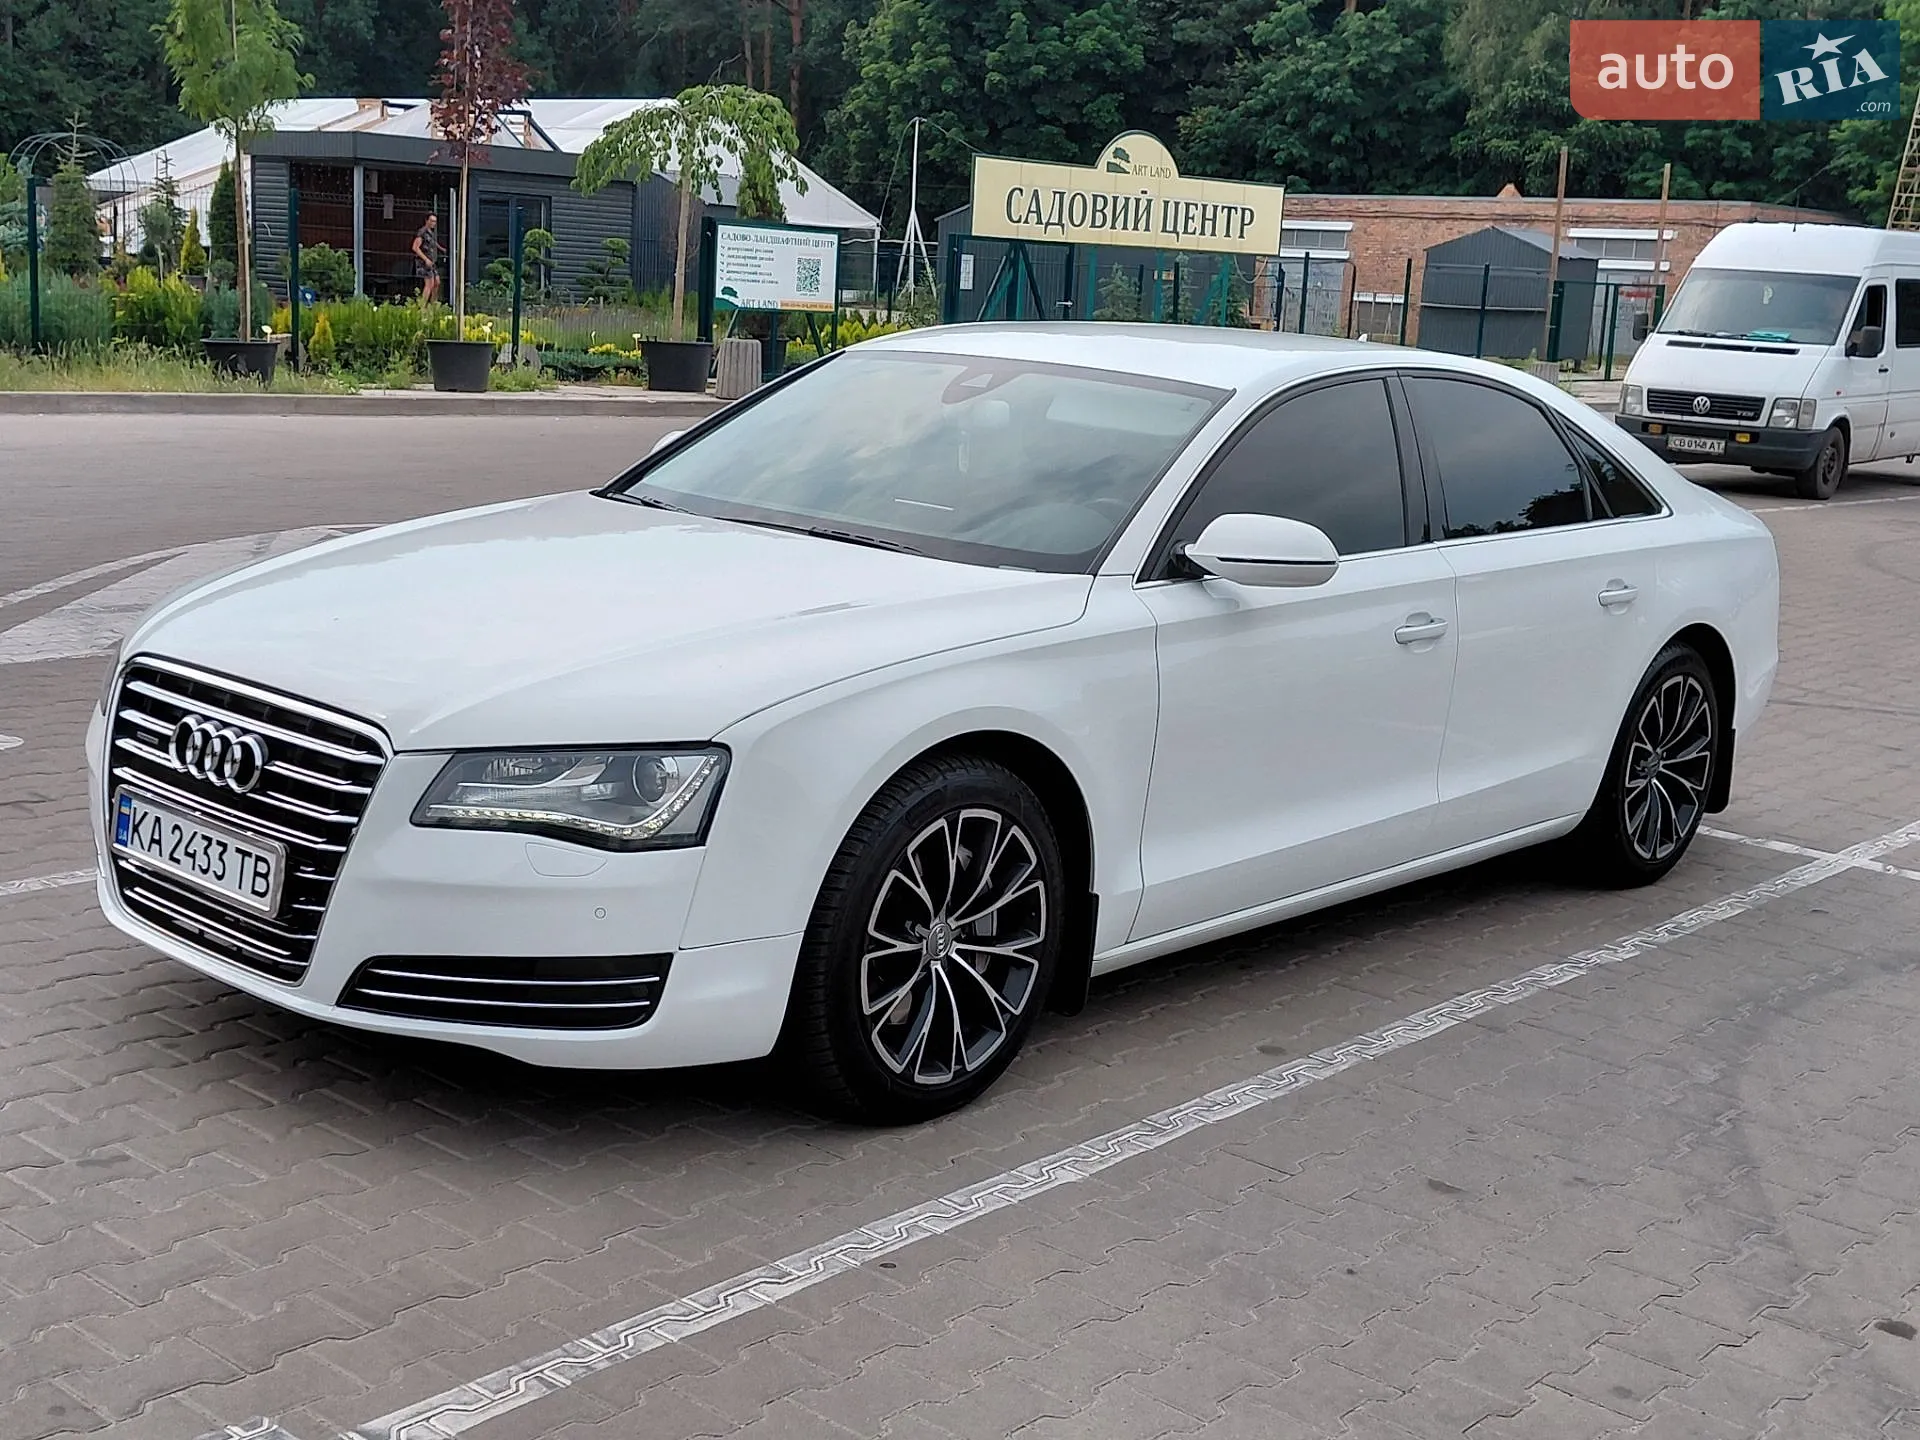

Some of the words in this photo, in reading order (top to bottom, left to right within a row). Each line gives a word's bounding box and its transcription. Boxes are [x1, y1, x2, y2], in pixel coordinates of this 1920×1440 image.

[1131, 164, 1148, 177] ART
[1149, 165, 1171, 179] LAND
[1006, 186, 1153, 235] САДОВИЙ
[1160, 199, 1255, 243] ЦЕНТР
[130, 806, 163, 858] KA
[168, 823, 228, 881] 2433
[234, 846, 271, 899] TB
